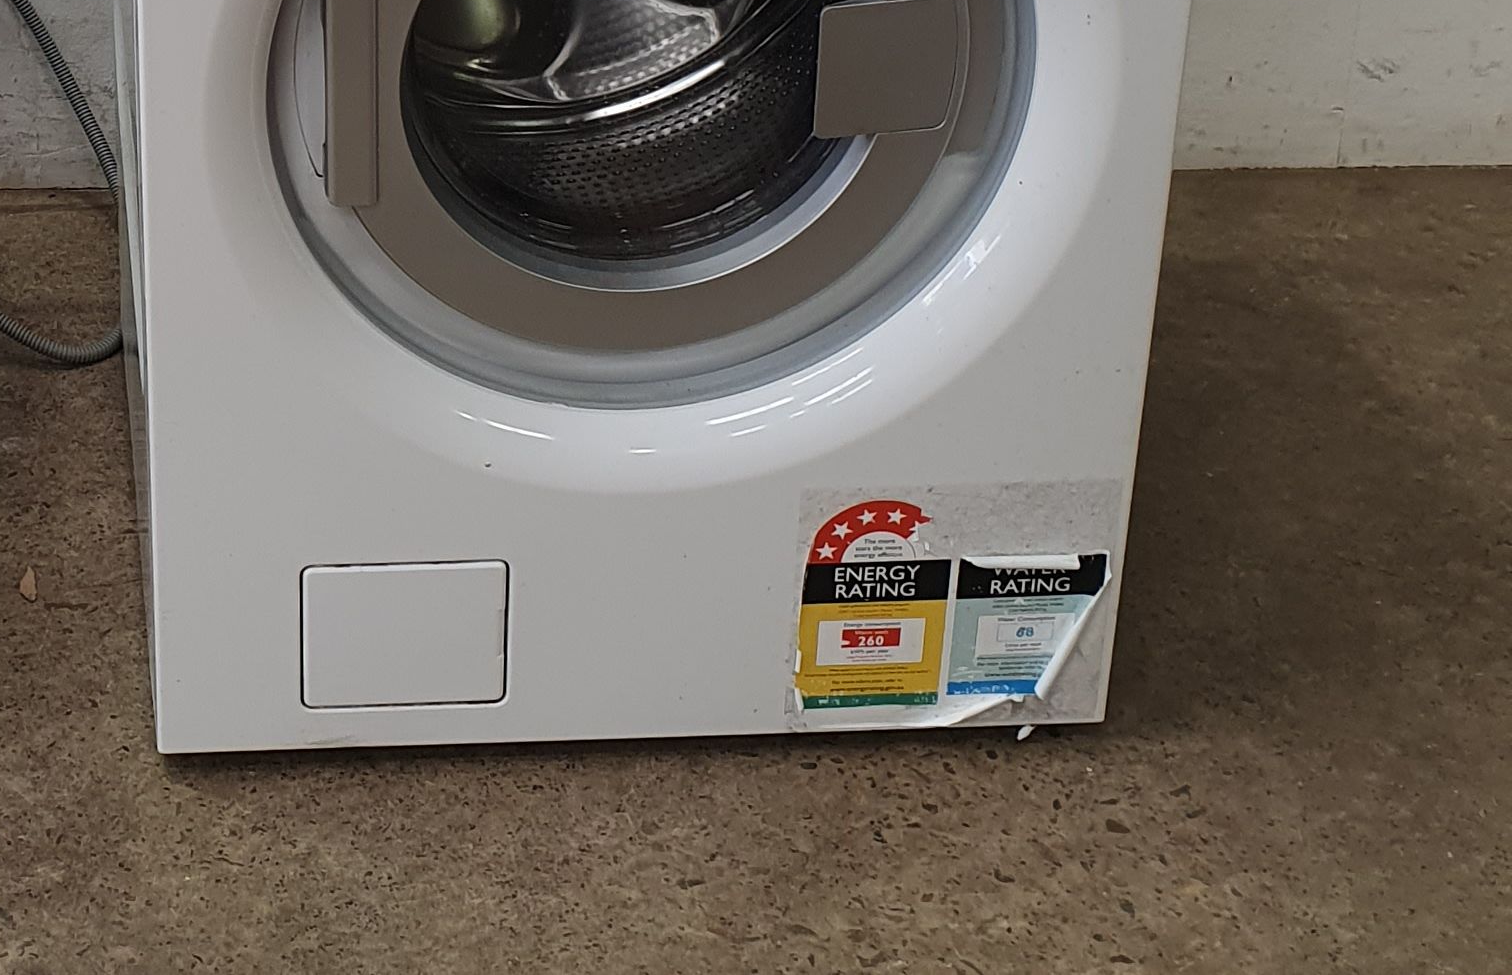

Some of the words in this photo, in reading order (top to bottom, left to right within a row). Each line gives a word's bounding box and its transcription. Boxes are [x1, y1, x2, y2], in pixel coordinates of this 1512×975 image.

[834, 565, 921, 583] ENERGY
[835, 582, 916, 599] RATING
[989, 576, 1071, 595] RATING
[858, 635, 885, 647] 260
